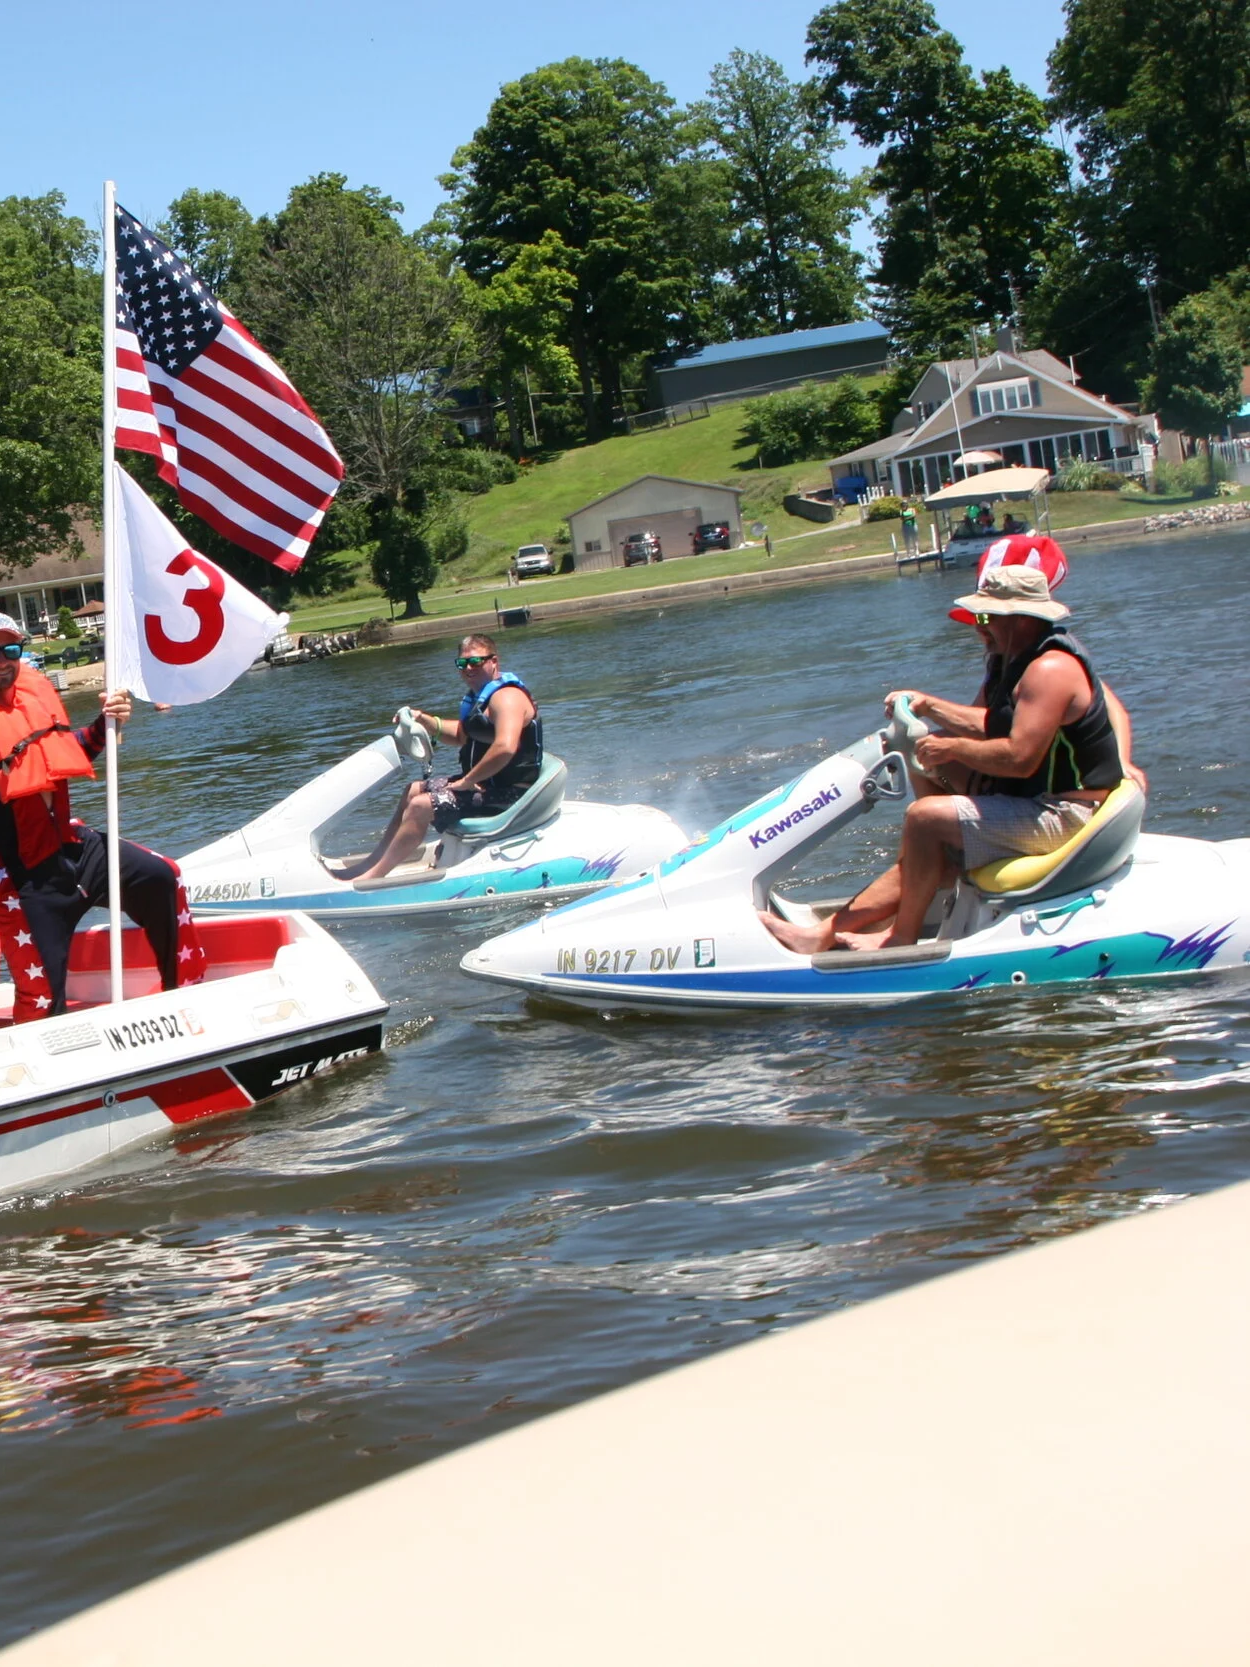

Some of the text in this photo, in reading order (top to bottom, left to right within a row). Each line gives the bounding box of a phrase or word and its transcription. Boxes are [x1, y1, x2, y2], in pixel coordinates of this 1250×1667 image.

[144, 548, 225, 665] 3
[748, 783, 842, 849] Kawasaki
[193, 881, 251, 903] 2445DX
[556, 948, 576, 974] IN
[584, 948, 638, 974] 9217
[649, 945, 682, 972] DV
[103, 1027, 126, 1052] IN
[121, 1019, 164, 1048] 2039
[271, 1061, 313, 1087] JET
